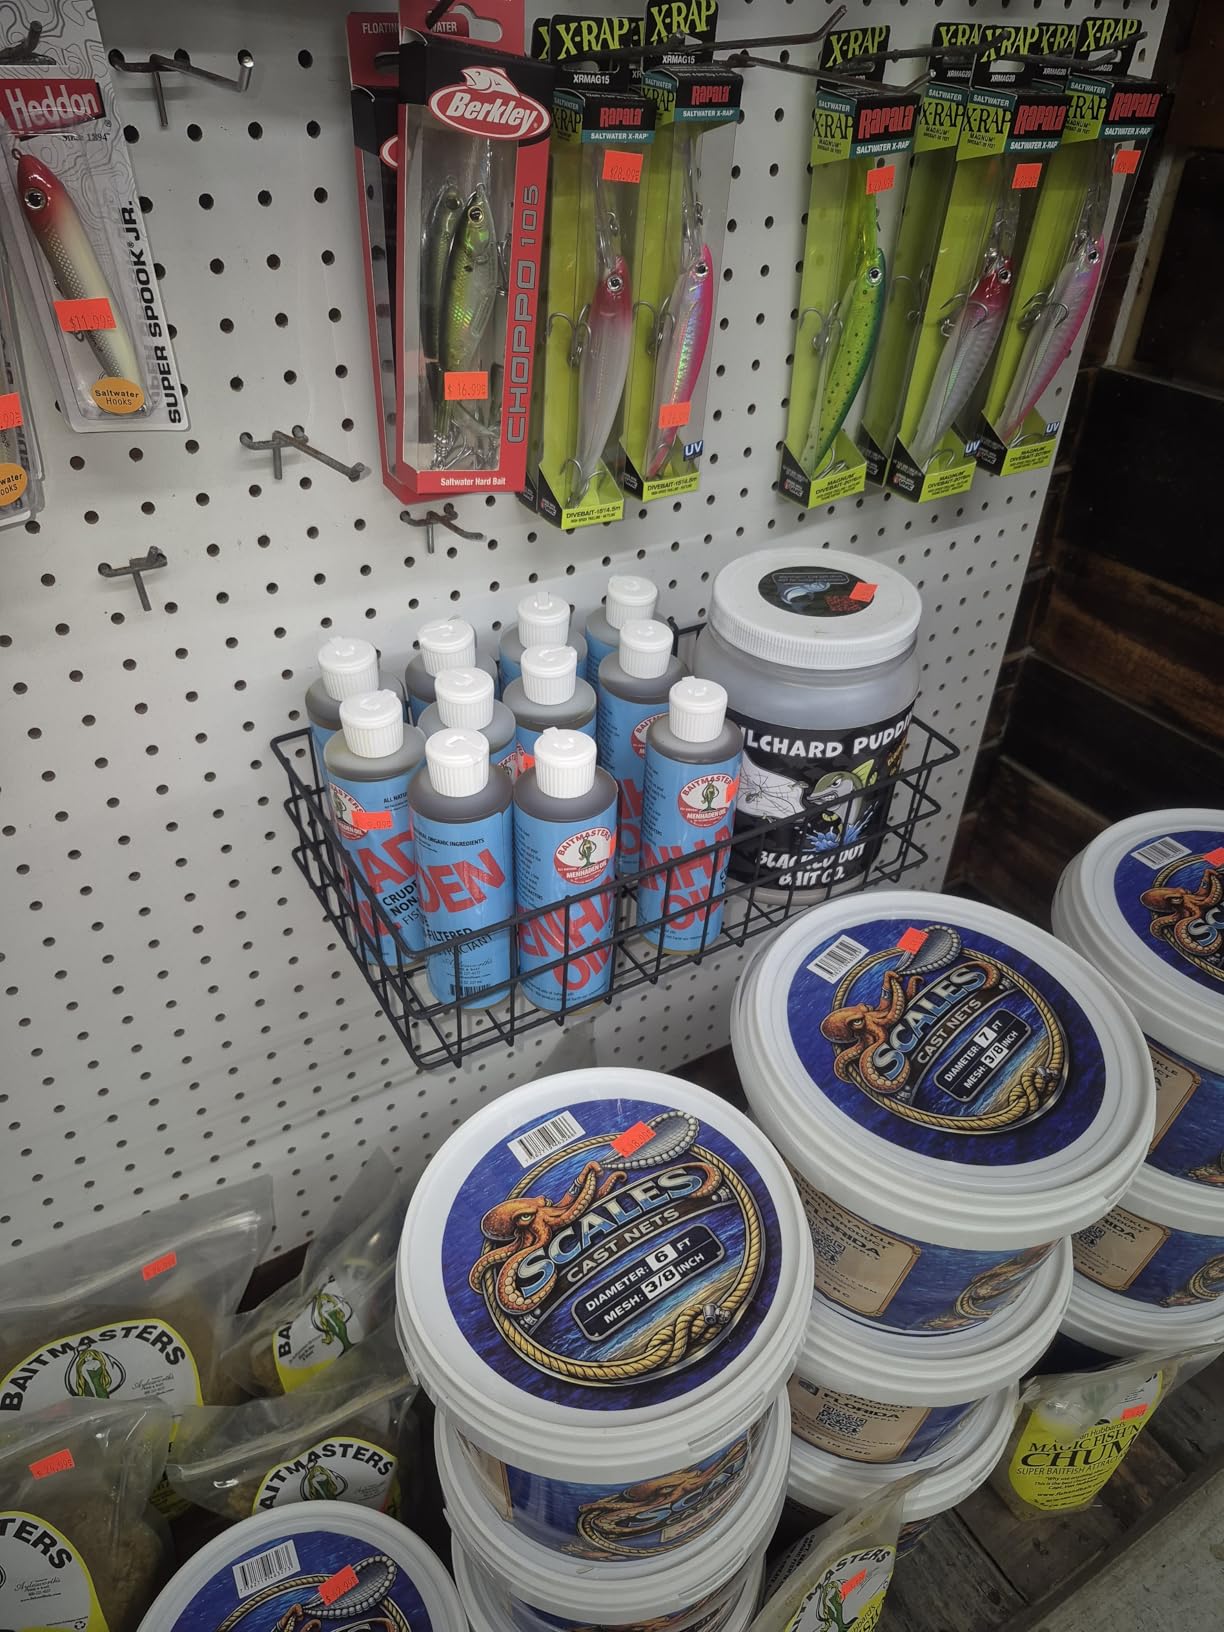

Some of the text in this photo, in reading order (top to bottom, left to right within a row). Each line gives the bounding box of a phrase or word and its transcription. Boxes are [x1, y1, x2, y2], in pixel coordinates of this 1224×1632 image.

[362, 22, 399, 34] FLOATIN
[650, 0, 716, 44] X-RAP
[556, 17, 629, 60] X-RAP
[825, 26, 886, 67] X-RAP
[939, 25, 979, 48] X-RA
[1039, 25, 1077, 55] X-RA
[1080, 18, 1138, 52] X-RAP
[662, 55, 696, 65] XRMAG15
[573, 74, 610, 84] XRMAG15
[990, 74, 1016, 83] XRMAG20
[1070, 81, 1106, 94] SALTWATER
[5, 84, 99, 129] Heddon
[818, 100, 850, 112] SALTWATER
[929, 89, 962, 101] SALTWATER
[972, 94, 1009, 107] SALTWATER
[445, 92, 538, 137] Berkley
[682, 110, 715, 118] SALTWATER
[814, 113, 856, 140] X-RAP
[919, 102, 966, 128] X-RAP
[963, 107, 1012, 134] X-RAP
[590, 132, 648, 140] SALTWATER X-RAP
[1010, 140, 1059, 150] SALTWATER X-RAP
[1105, 127, 1152, 136] SALTWATER X-RAP
[856, 141, 910, 154] SALTWATER X-RAP
[120, 200, 140, 241] JR.
[507, 185, 539, 443] CHOPPO 105
[94, 389, 140, 399] Saltwater
[154, 345, 182, 423] SUPER
[105, 397, 132, 406] Hooks
[1046, 422, 1059, 434] UV
[685, 442, 703, 456] UV
[965, 441, 980, 453] UV
[440, 477, 506, 487] Saltwater Hard Bait
[740, 727, 843, 758] ILCHARD
[687, 811, 719, 819] MENHADEN
[449, 838, 485, 847] INGREDIENTS
[566, 864, 600, 879] MENHADEN
[872, 963, 990, 1080] SCALES
[916, 998, 984, 1065] CAST NETS
[943, 1043, 981, 1083] DIAMETER:
[992, 1019, 1003, 1031] FT
[963, 1030, 1019, 1089] MESH: 3/8 INCH
[516, 1167, 702, 1298] SCALES
[805, 1199, 881, 1257] FLORIDA
[832, 1214, 889, 1250] PRODUCT
[847, 1218, 896, 1247] TACKLE
[566, 1208, 680, 1283] CAST NETS
[585, 1237, 692, 1312] DIAMETER: 6 FT
[603, 1253, 705, 1325] MESH: 3/8 INCH
[1, 1325, 186, 1411] BAITMASTERS
[822, 1392, 900, 1419] FLORIDA
[259, 1444, 393, 1510] AITMASTERS
[1016, 1467, 1045, 1475] SUPER
[1046, 1465, 1085, 1475] BAITFISH
